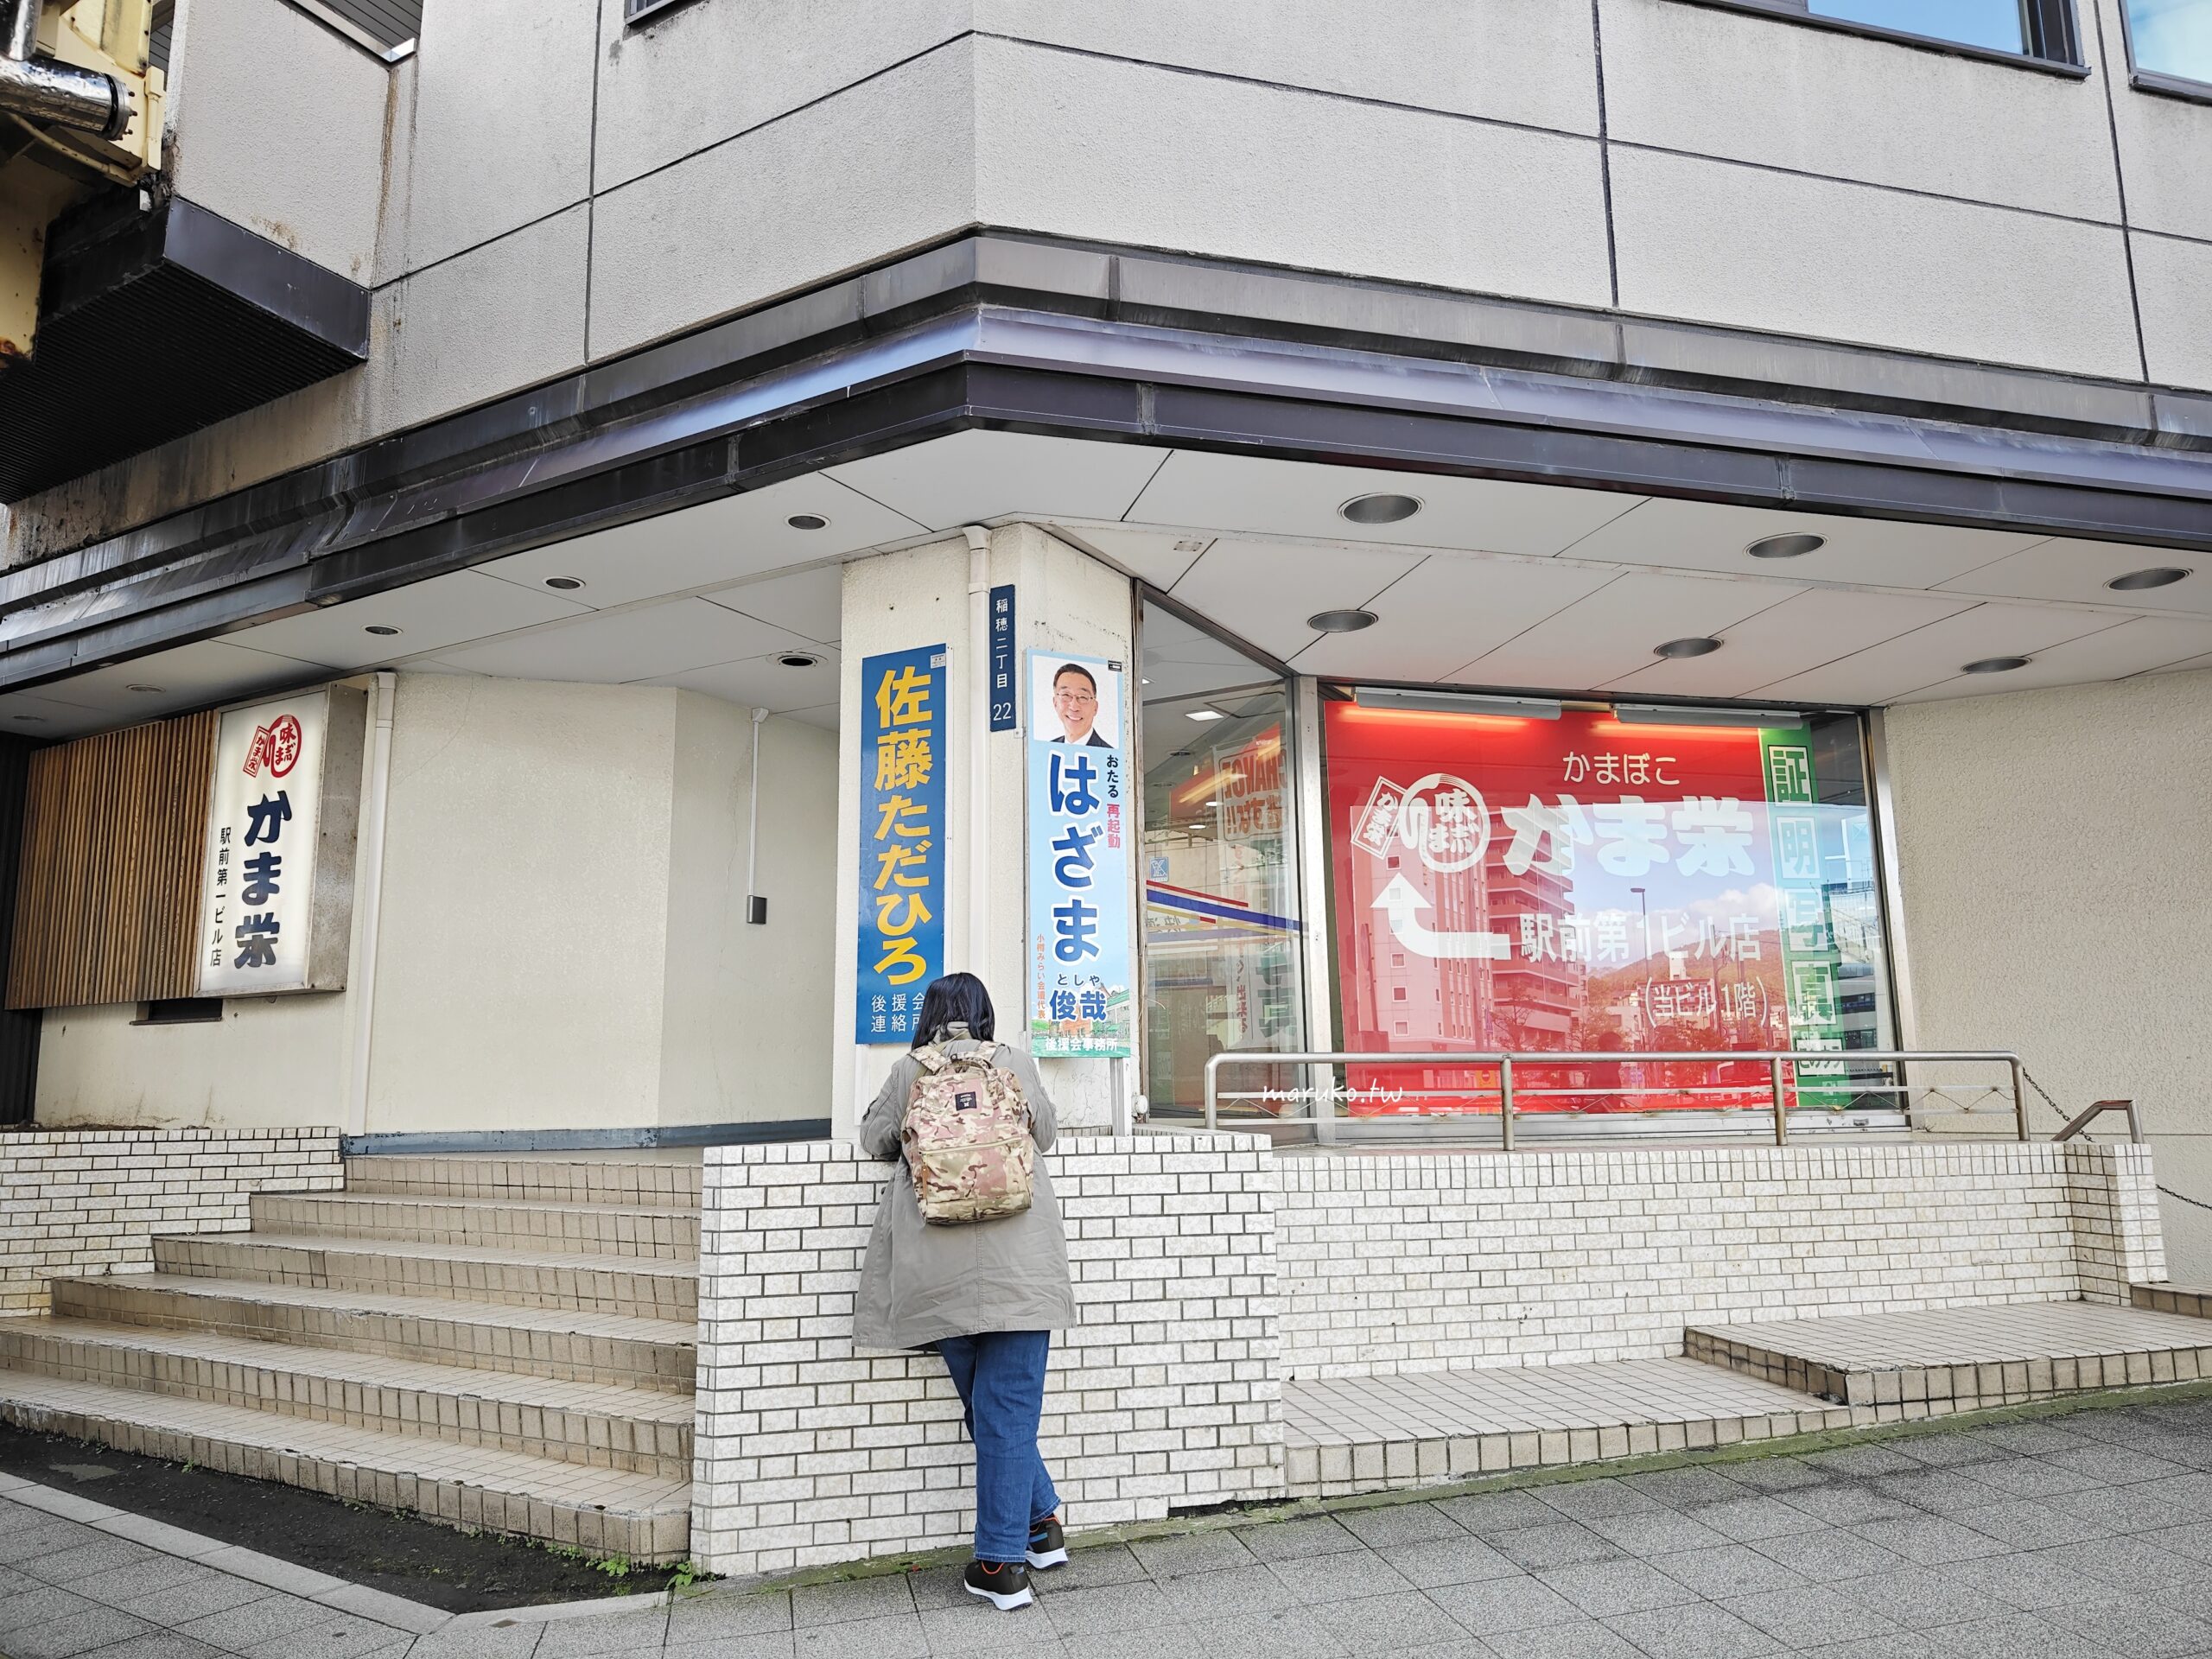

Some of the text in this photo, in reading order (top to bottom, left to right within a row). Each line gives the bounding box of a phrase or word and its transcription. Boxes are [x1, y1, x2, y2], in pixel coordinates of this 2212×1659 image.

[993, 598, 1012, 721] 稲穂二丁目 22
[1106, 754, 1121, 849] おたる 再起動
[1562, 749, 1681, 785] かまぼこ
[874, 666, 933, 985] 佐藤ただひろ
[1049, 753, 1103, 966] はざま
[1500, 793, 1755, 876] かま栄
[210, 827, 231, 967] 駅前第一ビル店
[234, 791, 292, 969] かま栄
[1058, 974, 1100, 986] としや
[1521, 913, 1761, 963] 駅前第1ビル店
[1045, 1037, 1118, 1052] 後援会事務所
[1050, 990, 1106, 1020] 俊哉
